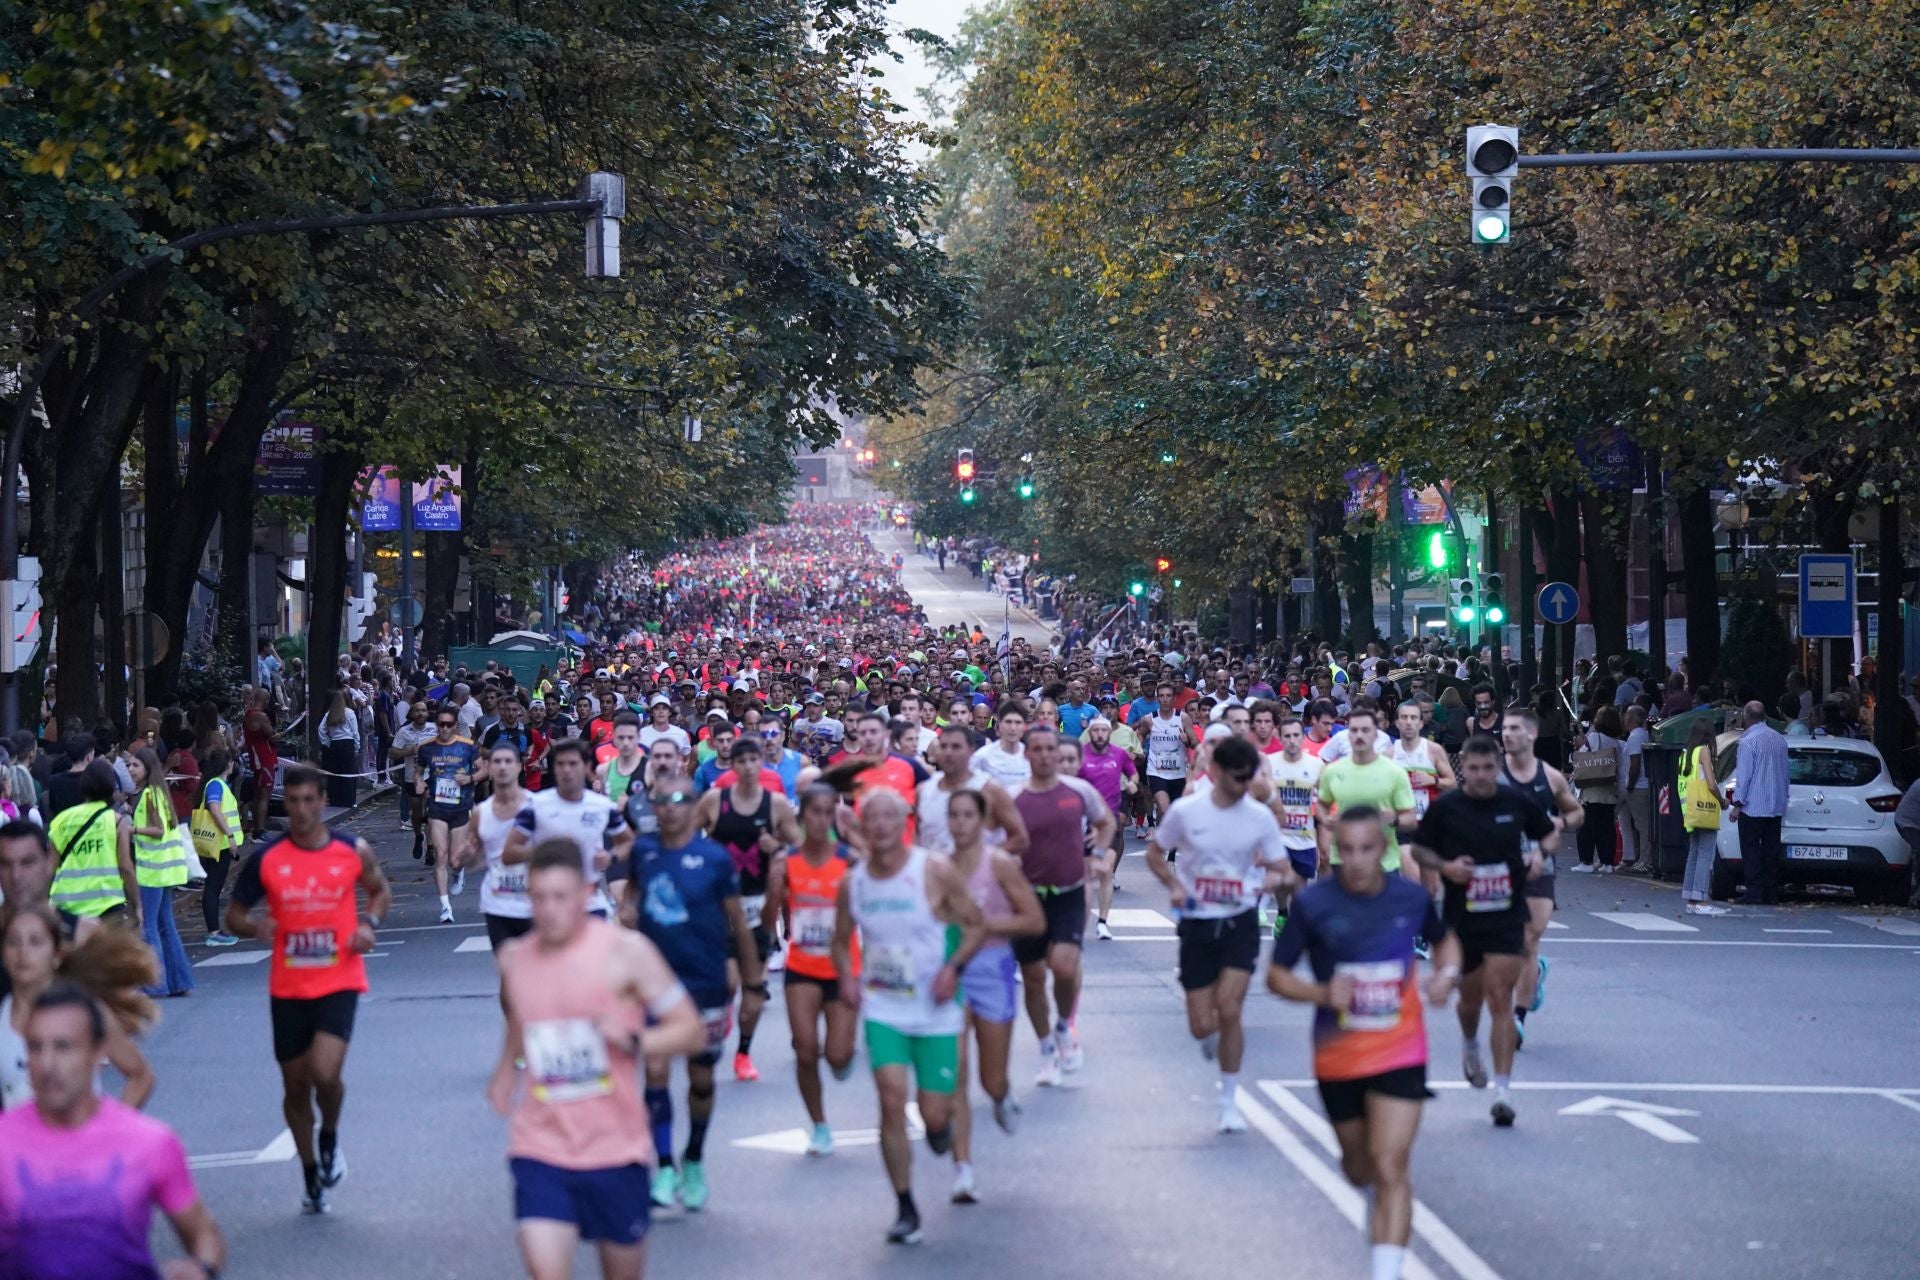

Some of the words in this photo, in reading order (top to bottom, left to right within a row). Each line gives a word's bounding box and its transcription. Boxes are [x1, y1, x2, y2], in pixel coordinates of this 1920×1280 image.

[364, 503, 389, 513] Carlos
[417, 504, 431, 512] Luz
[424, 511, 449, 519] Castro
[1794, 847, 1822, 857] 6748
[1826, 848, 1846, 858] JHF
